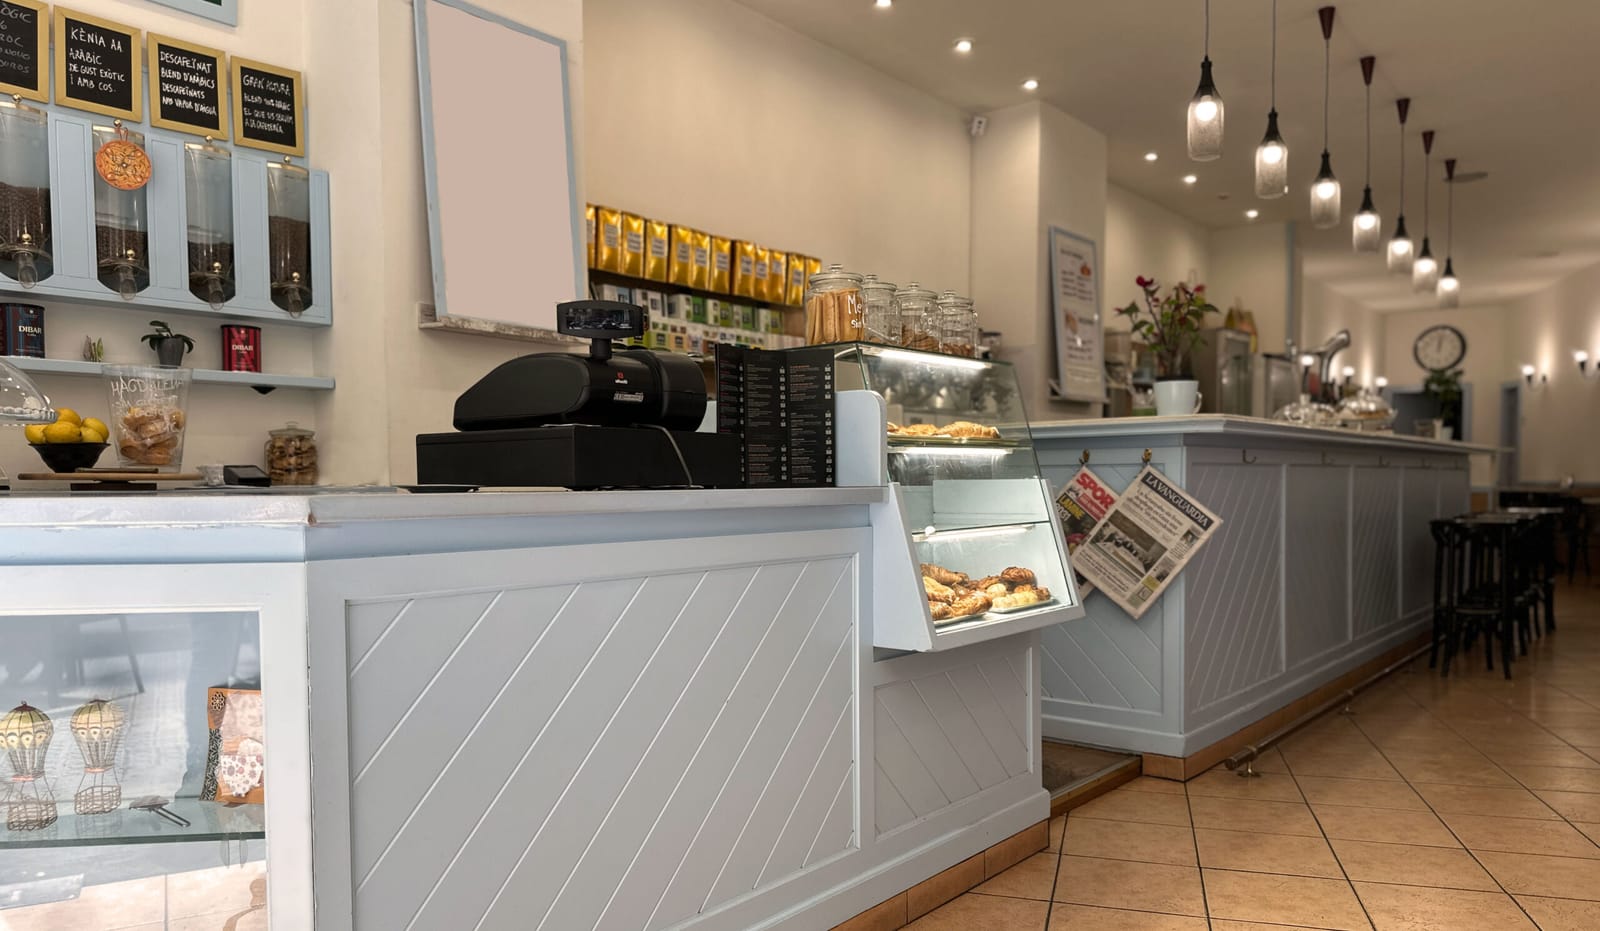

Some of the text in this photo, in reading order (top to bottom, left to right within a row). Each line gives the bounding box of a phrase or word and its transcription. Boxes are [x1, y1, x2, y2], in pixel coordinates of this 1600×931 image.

[110, 38, 123, 52] AA
[69, 63, 79, 73] DE
[80, 65, 97, 76] GUST
[161, 67, 182, 80] BLEND
[77, 77, 95, 89] AMB
[1146, 475, 1159, 489] LA
[1156, 483, 1209, 527] VANGUARDIA
